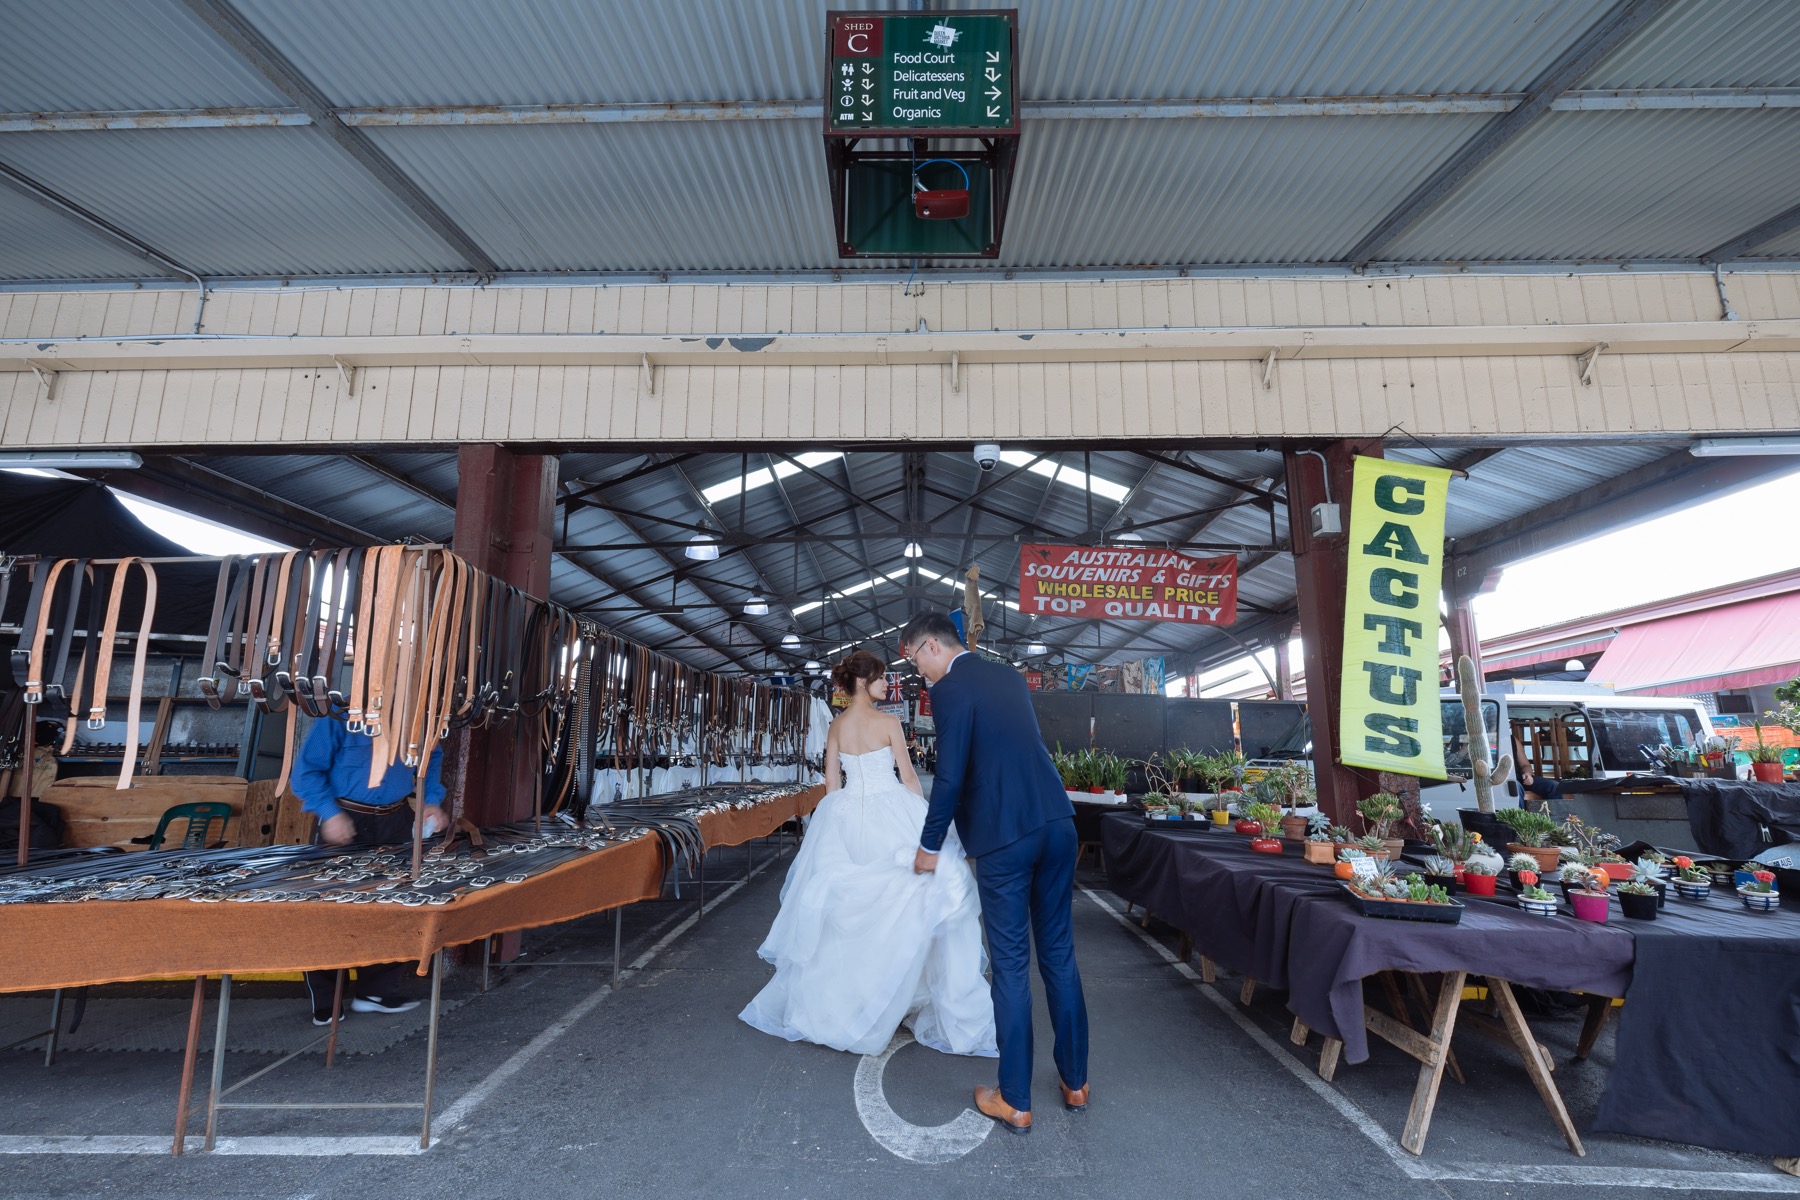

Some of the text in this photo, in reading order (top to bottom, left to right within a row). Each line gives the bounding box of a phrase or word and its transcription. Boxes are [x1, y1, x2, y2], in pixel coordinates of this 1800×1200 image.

[844, 23, 873, 31] SHED
[847, 33, 869, 53] C
[893, 53, 955, 64] Food Court
[893, 70, 965, 82] Delicatessens
[893, 88, 966, 102] Fruit and Veg
[893, 107, 942, 120] Organics
[1062, 550, 1197, 571] AUSTRALIAN
[1024, 563, 1232, 589] SOUVENIRS & GIFTS
[1037, 580, 1220, 605] WHOLESALE PRICE
[1033, 596, 1222, 621] TOP QUALITY
[1362, 474, 1430, 758] CACTUS
